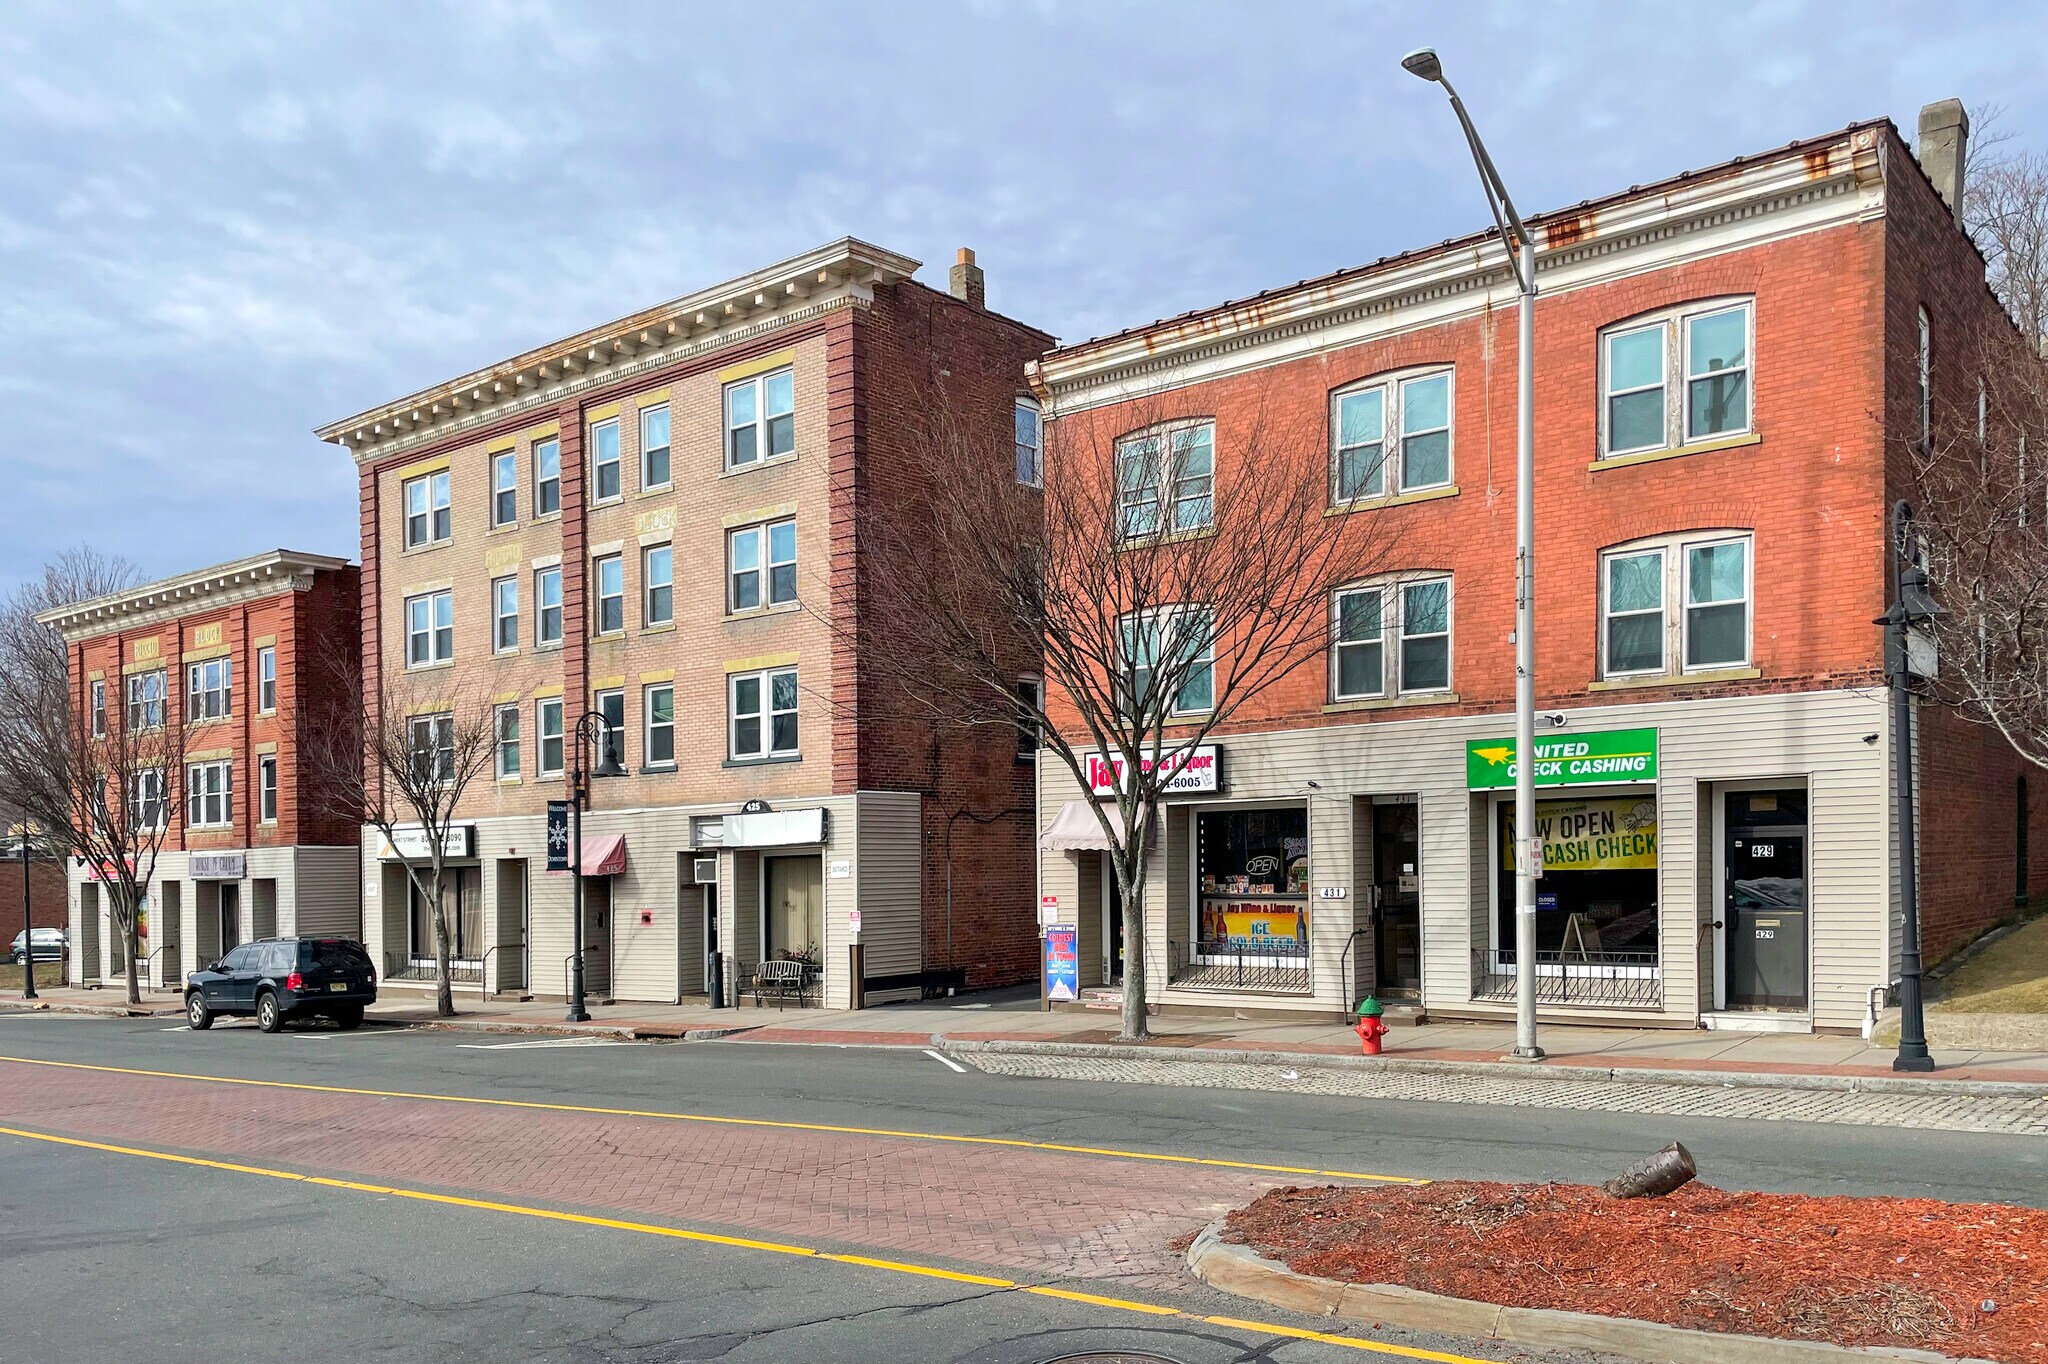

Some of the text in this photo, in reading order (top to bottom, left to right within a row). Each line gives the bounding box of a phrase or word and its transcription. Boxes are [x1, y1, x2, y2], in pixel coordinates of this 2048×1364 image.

[637, 508, 678, 531] BLOCK
[195, 626, 220, 643] BLOCK
[1533, 742, 1589, 758] NITED
[1507, 757, 1646, 777] CECK CASHING
[746, 803, 760, 811] 425
[1508, 810, 1615, 844] NW OPEN
[1543, 840, 1590, 865] CASH
[1752, 846, 1773, 856] 429
[1246, 860, 1279, 873] OPEN
[1323, 888, 1341, 897] 431
[1227, 903, 1296, 914] Jay Wine & Liquor
[1251, 922, 1270, 935] ICE
[1756, 930, 1774, 938] 429
[1049, 933, 1074, 942] COLDEST
